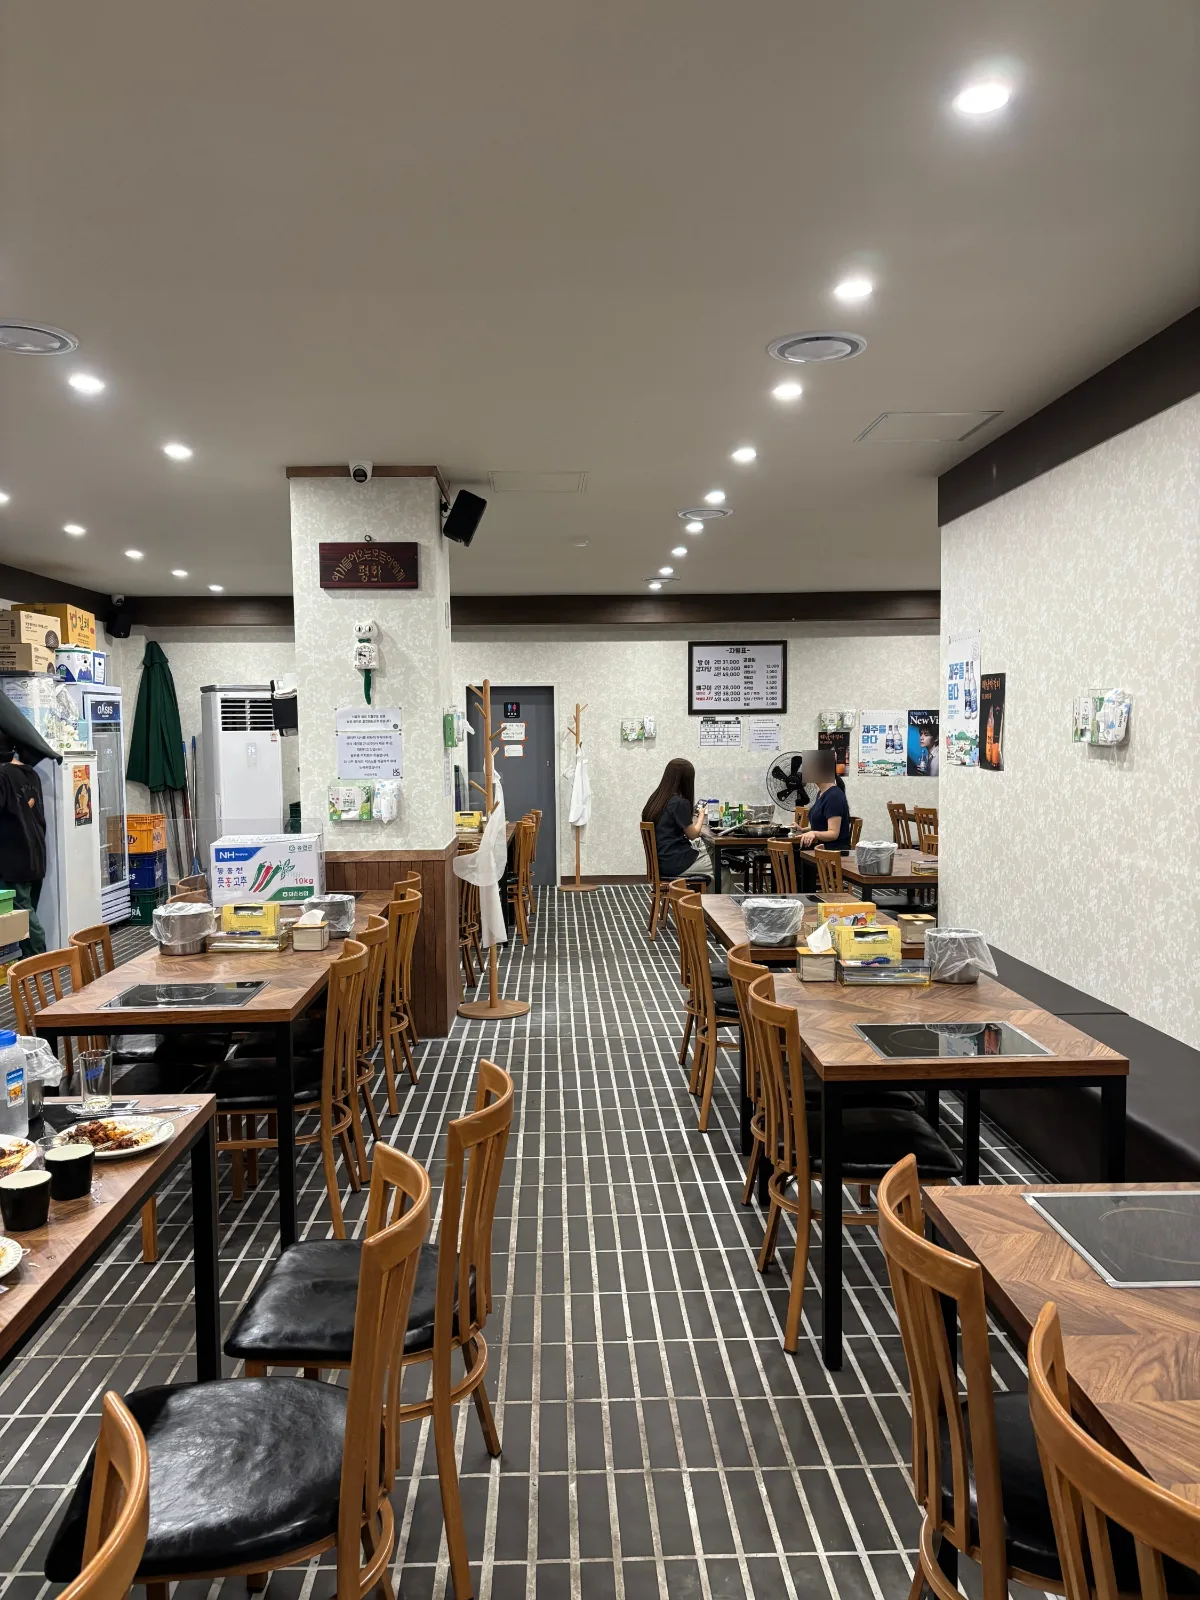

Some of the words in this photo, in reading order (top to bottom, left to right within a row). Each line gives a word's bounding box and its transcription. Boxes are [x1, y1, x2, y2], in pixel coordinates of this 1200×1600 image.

[948, 661, 965, 680] 제주를
[947, 683, 959, 700] 담다
[910, 715, 930, 725] New
[862, 724, 886, 734] 제주를
[862, 735, 878, 744] 담다
[219, 851, 235, 859] NH
